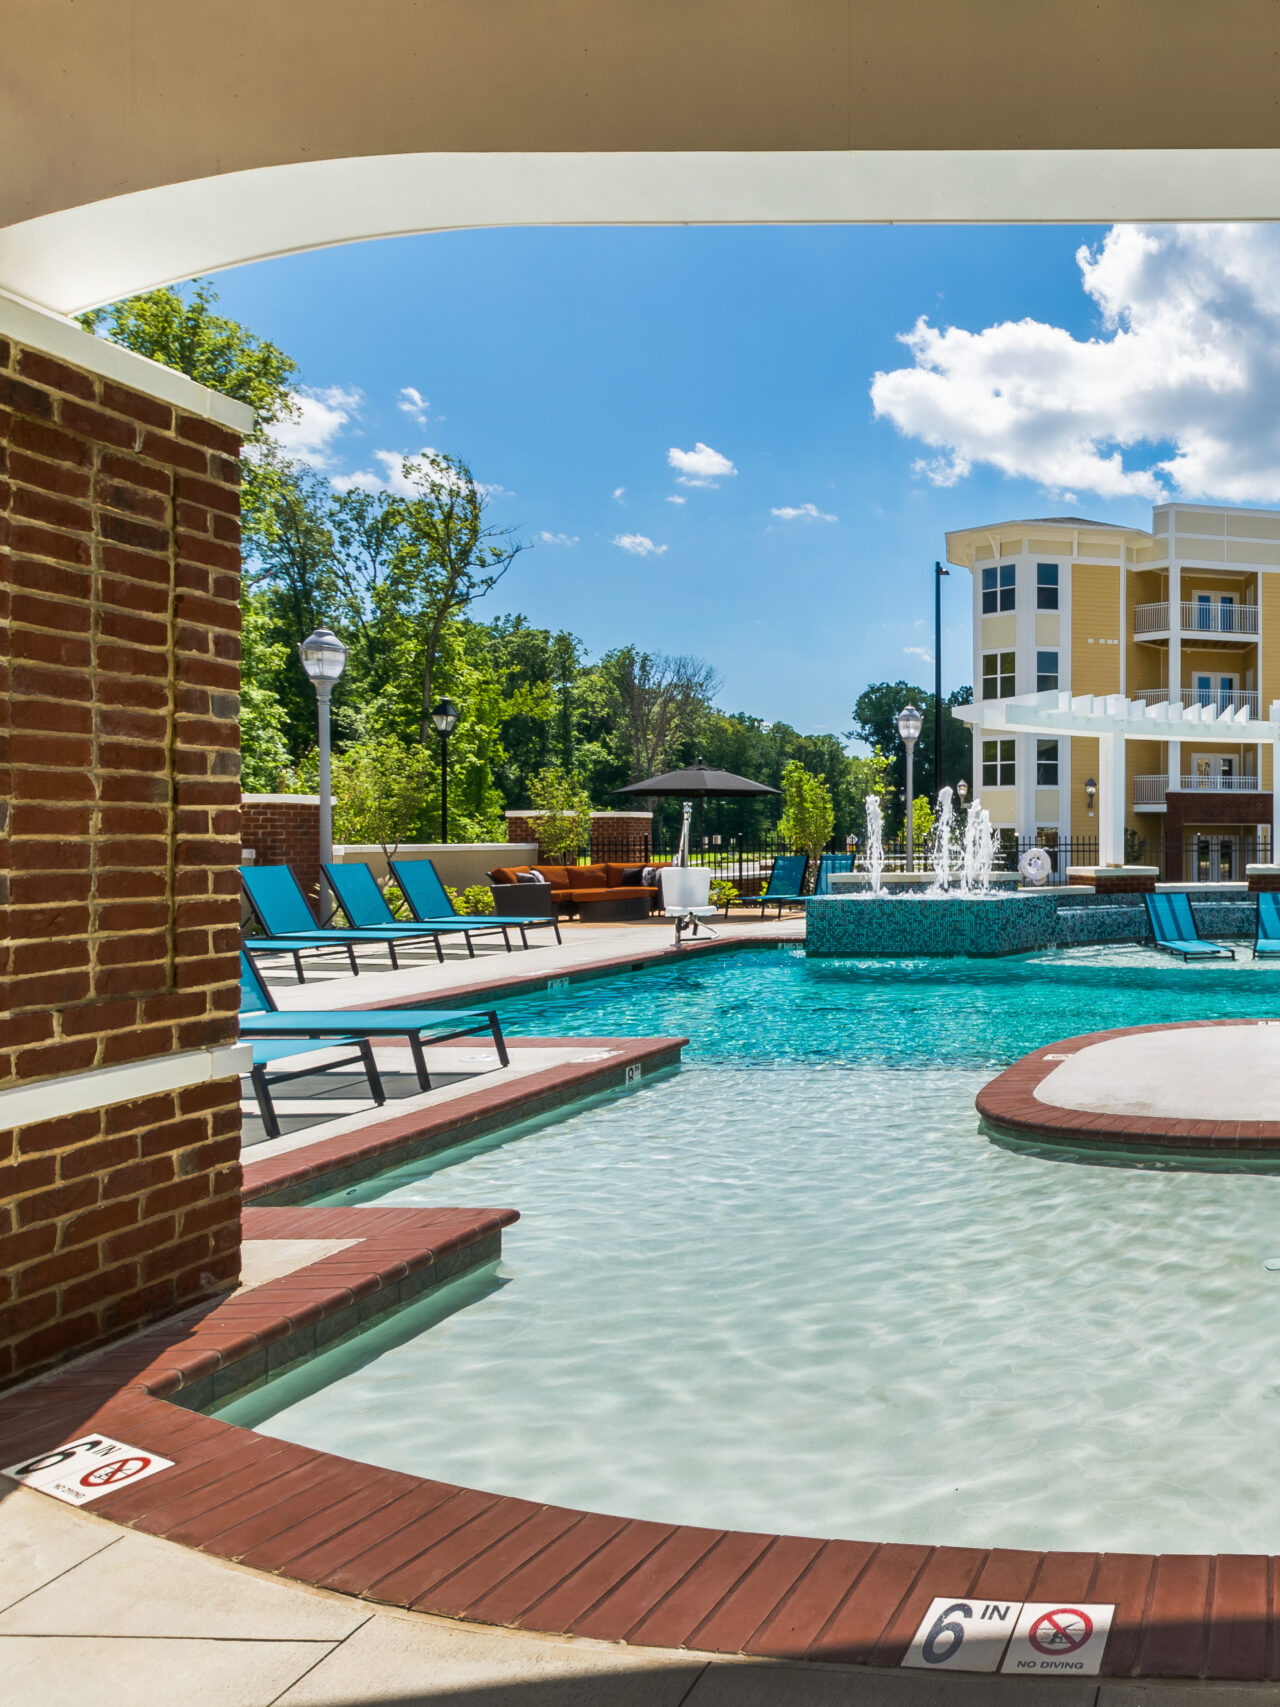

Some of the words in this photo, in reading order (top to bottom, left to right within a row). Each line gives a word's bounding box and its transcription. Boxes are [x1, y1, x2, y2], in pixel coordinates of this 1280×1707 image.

[14, 1440, 103, 1475] 6
[93, 1444, 122, 1458] IN
[921, 1603, 973, 1664] 6
[980, 1604, 1011, 1621] IN
[1016, 1660, 1038, 1669] NO
[1040, 1660, 1084, 1670] DIVING
